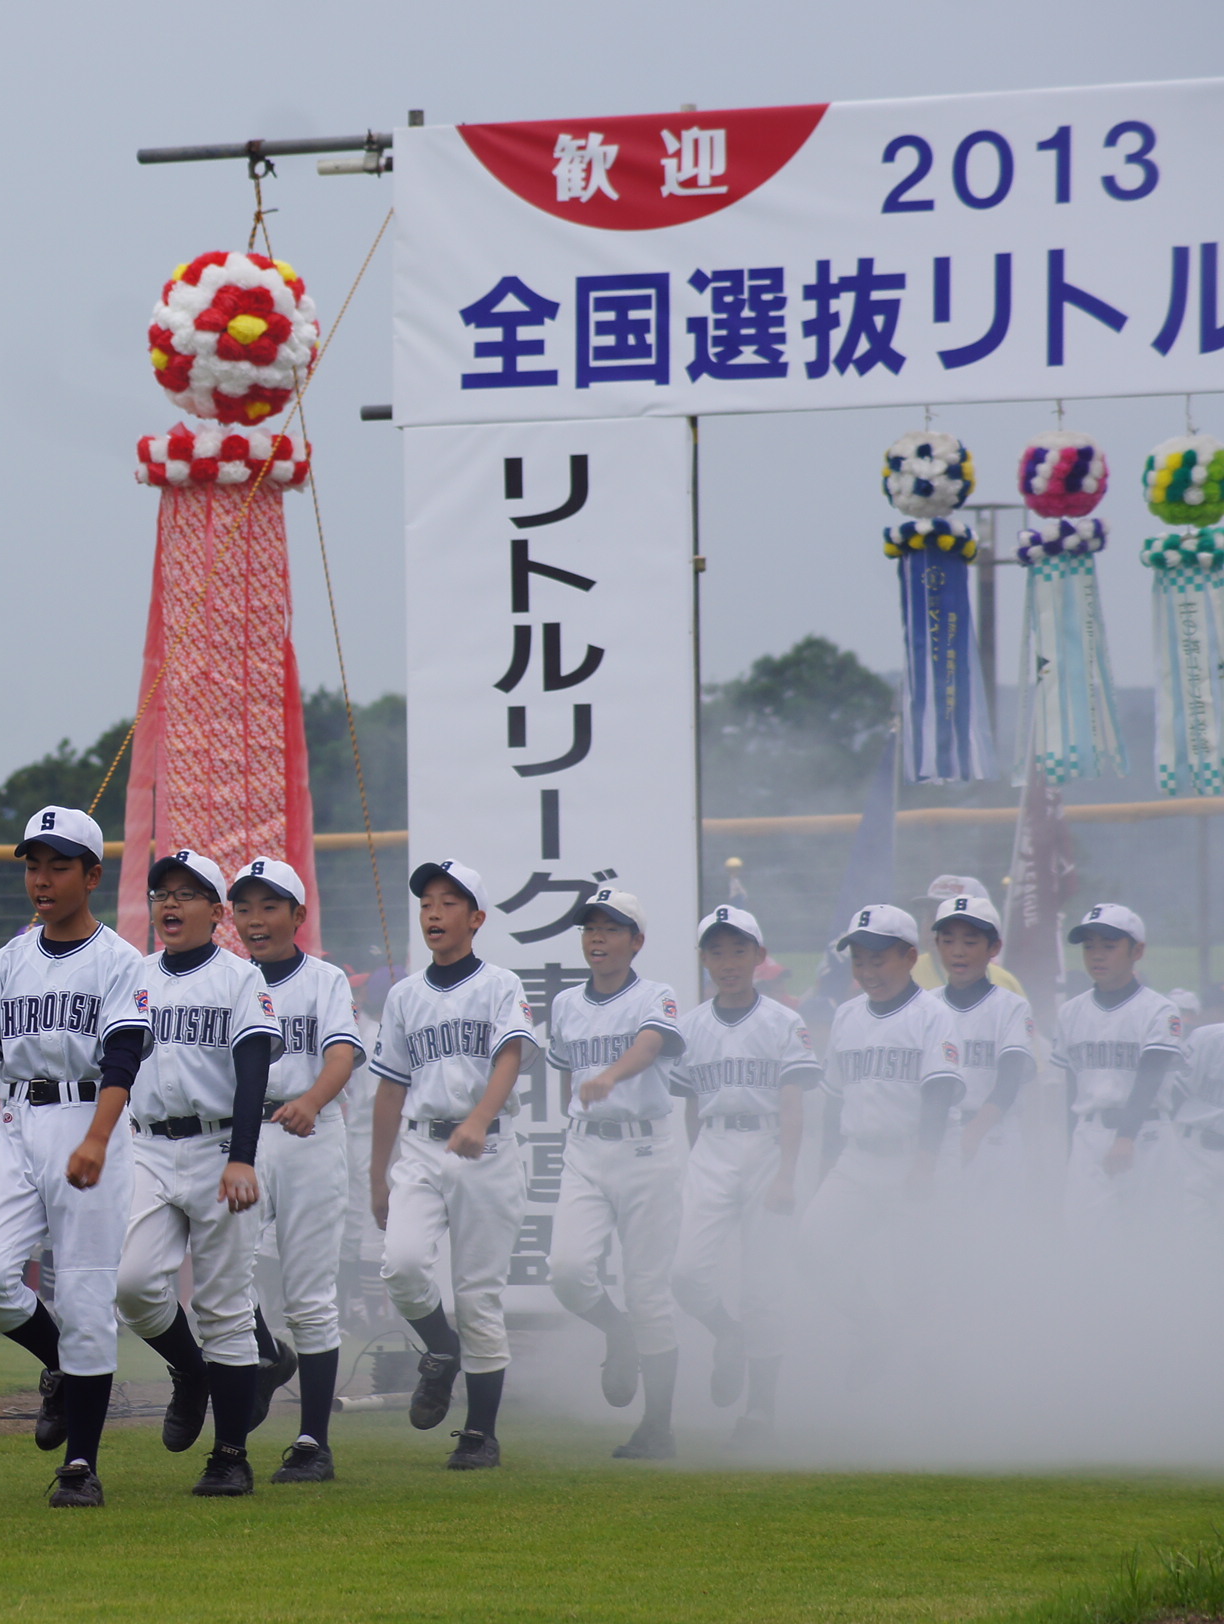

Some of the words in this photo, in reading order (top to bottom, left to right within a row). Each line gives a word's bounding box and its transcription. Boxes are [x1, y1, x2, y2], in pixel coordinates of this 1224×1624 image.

[552, 126, 730, 204] 歓迎
[880, 119, 1162, 215] 2013
[459, 242, 1224, 390] 全国選抜リトル
[41, 812, 56, 830] S
[250, 861, 265, 876] S
[0, 991, 102, 1040] HIROISH
